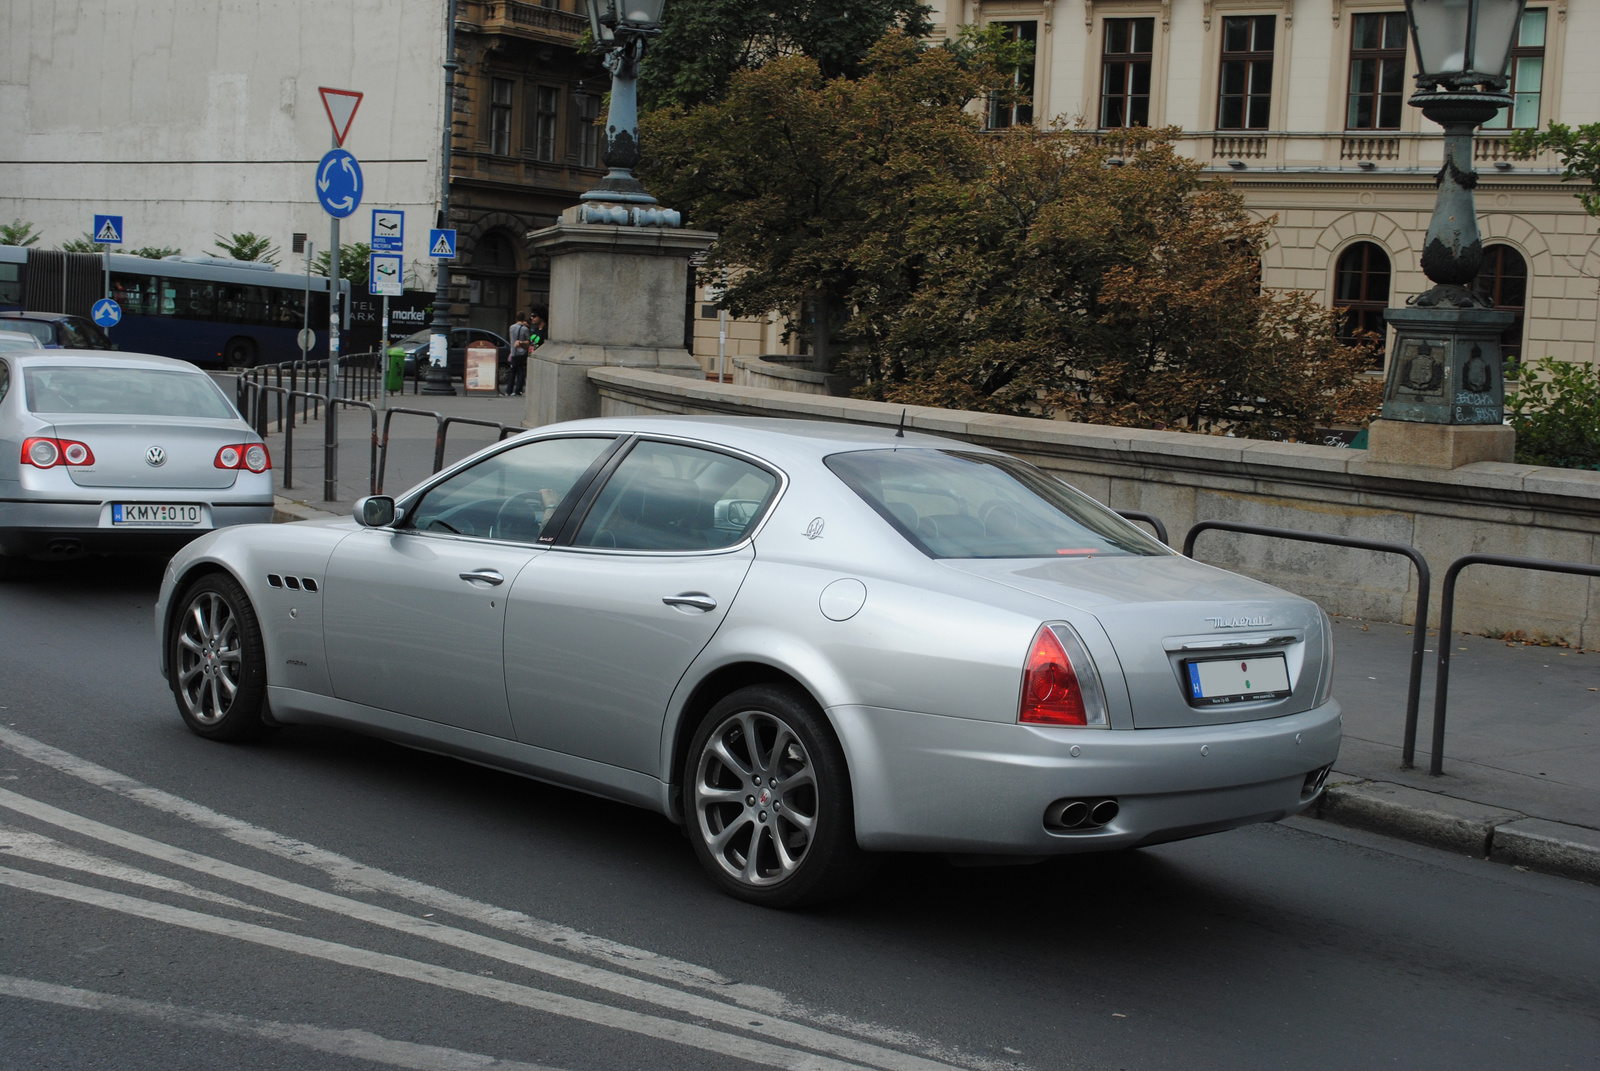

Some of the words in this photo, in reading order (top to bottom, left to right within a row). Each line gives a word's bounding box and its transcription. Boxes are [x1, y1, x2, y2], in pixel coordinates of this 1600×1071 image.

[352, 302, 375, 310] TEL
[392, 306, 425, 320] market
[1193, 682, 1200, 693] H
